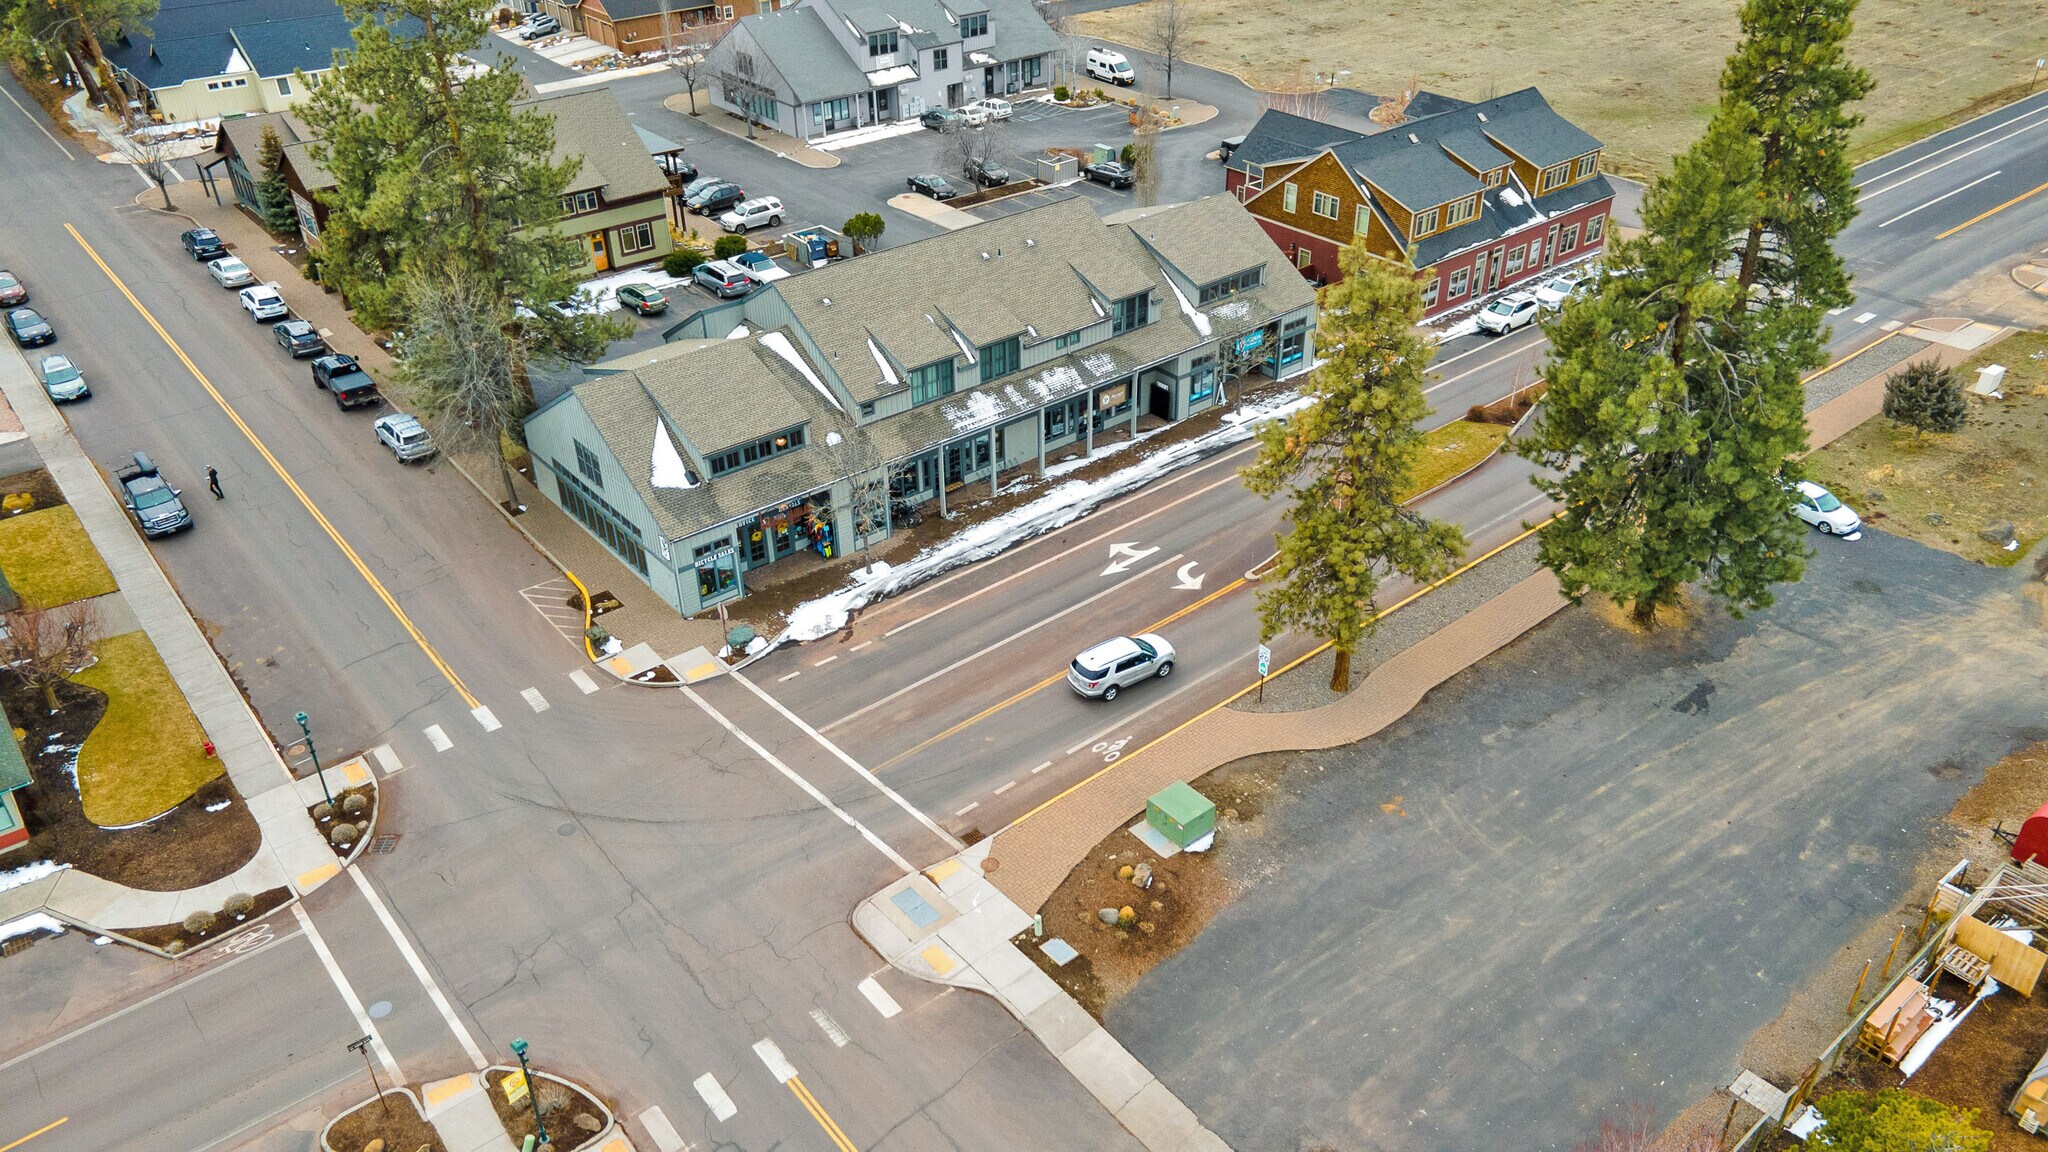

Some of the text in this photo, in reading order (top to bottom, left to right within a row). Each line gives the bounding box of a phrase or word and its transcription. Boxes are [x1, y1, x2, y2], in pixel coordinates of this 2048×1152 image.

[694, 548, 735, 567] BICYCLE SALES
[1259, 652, 1269, 662] 20
